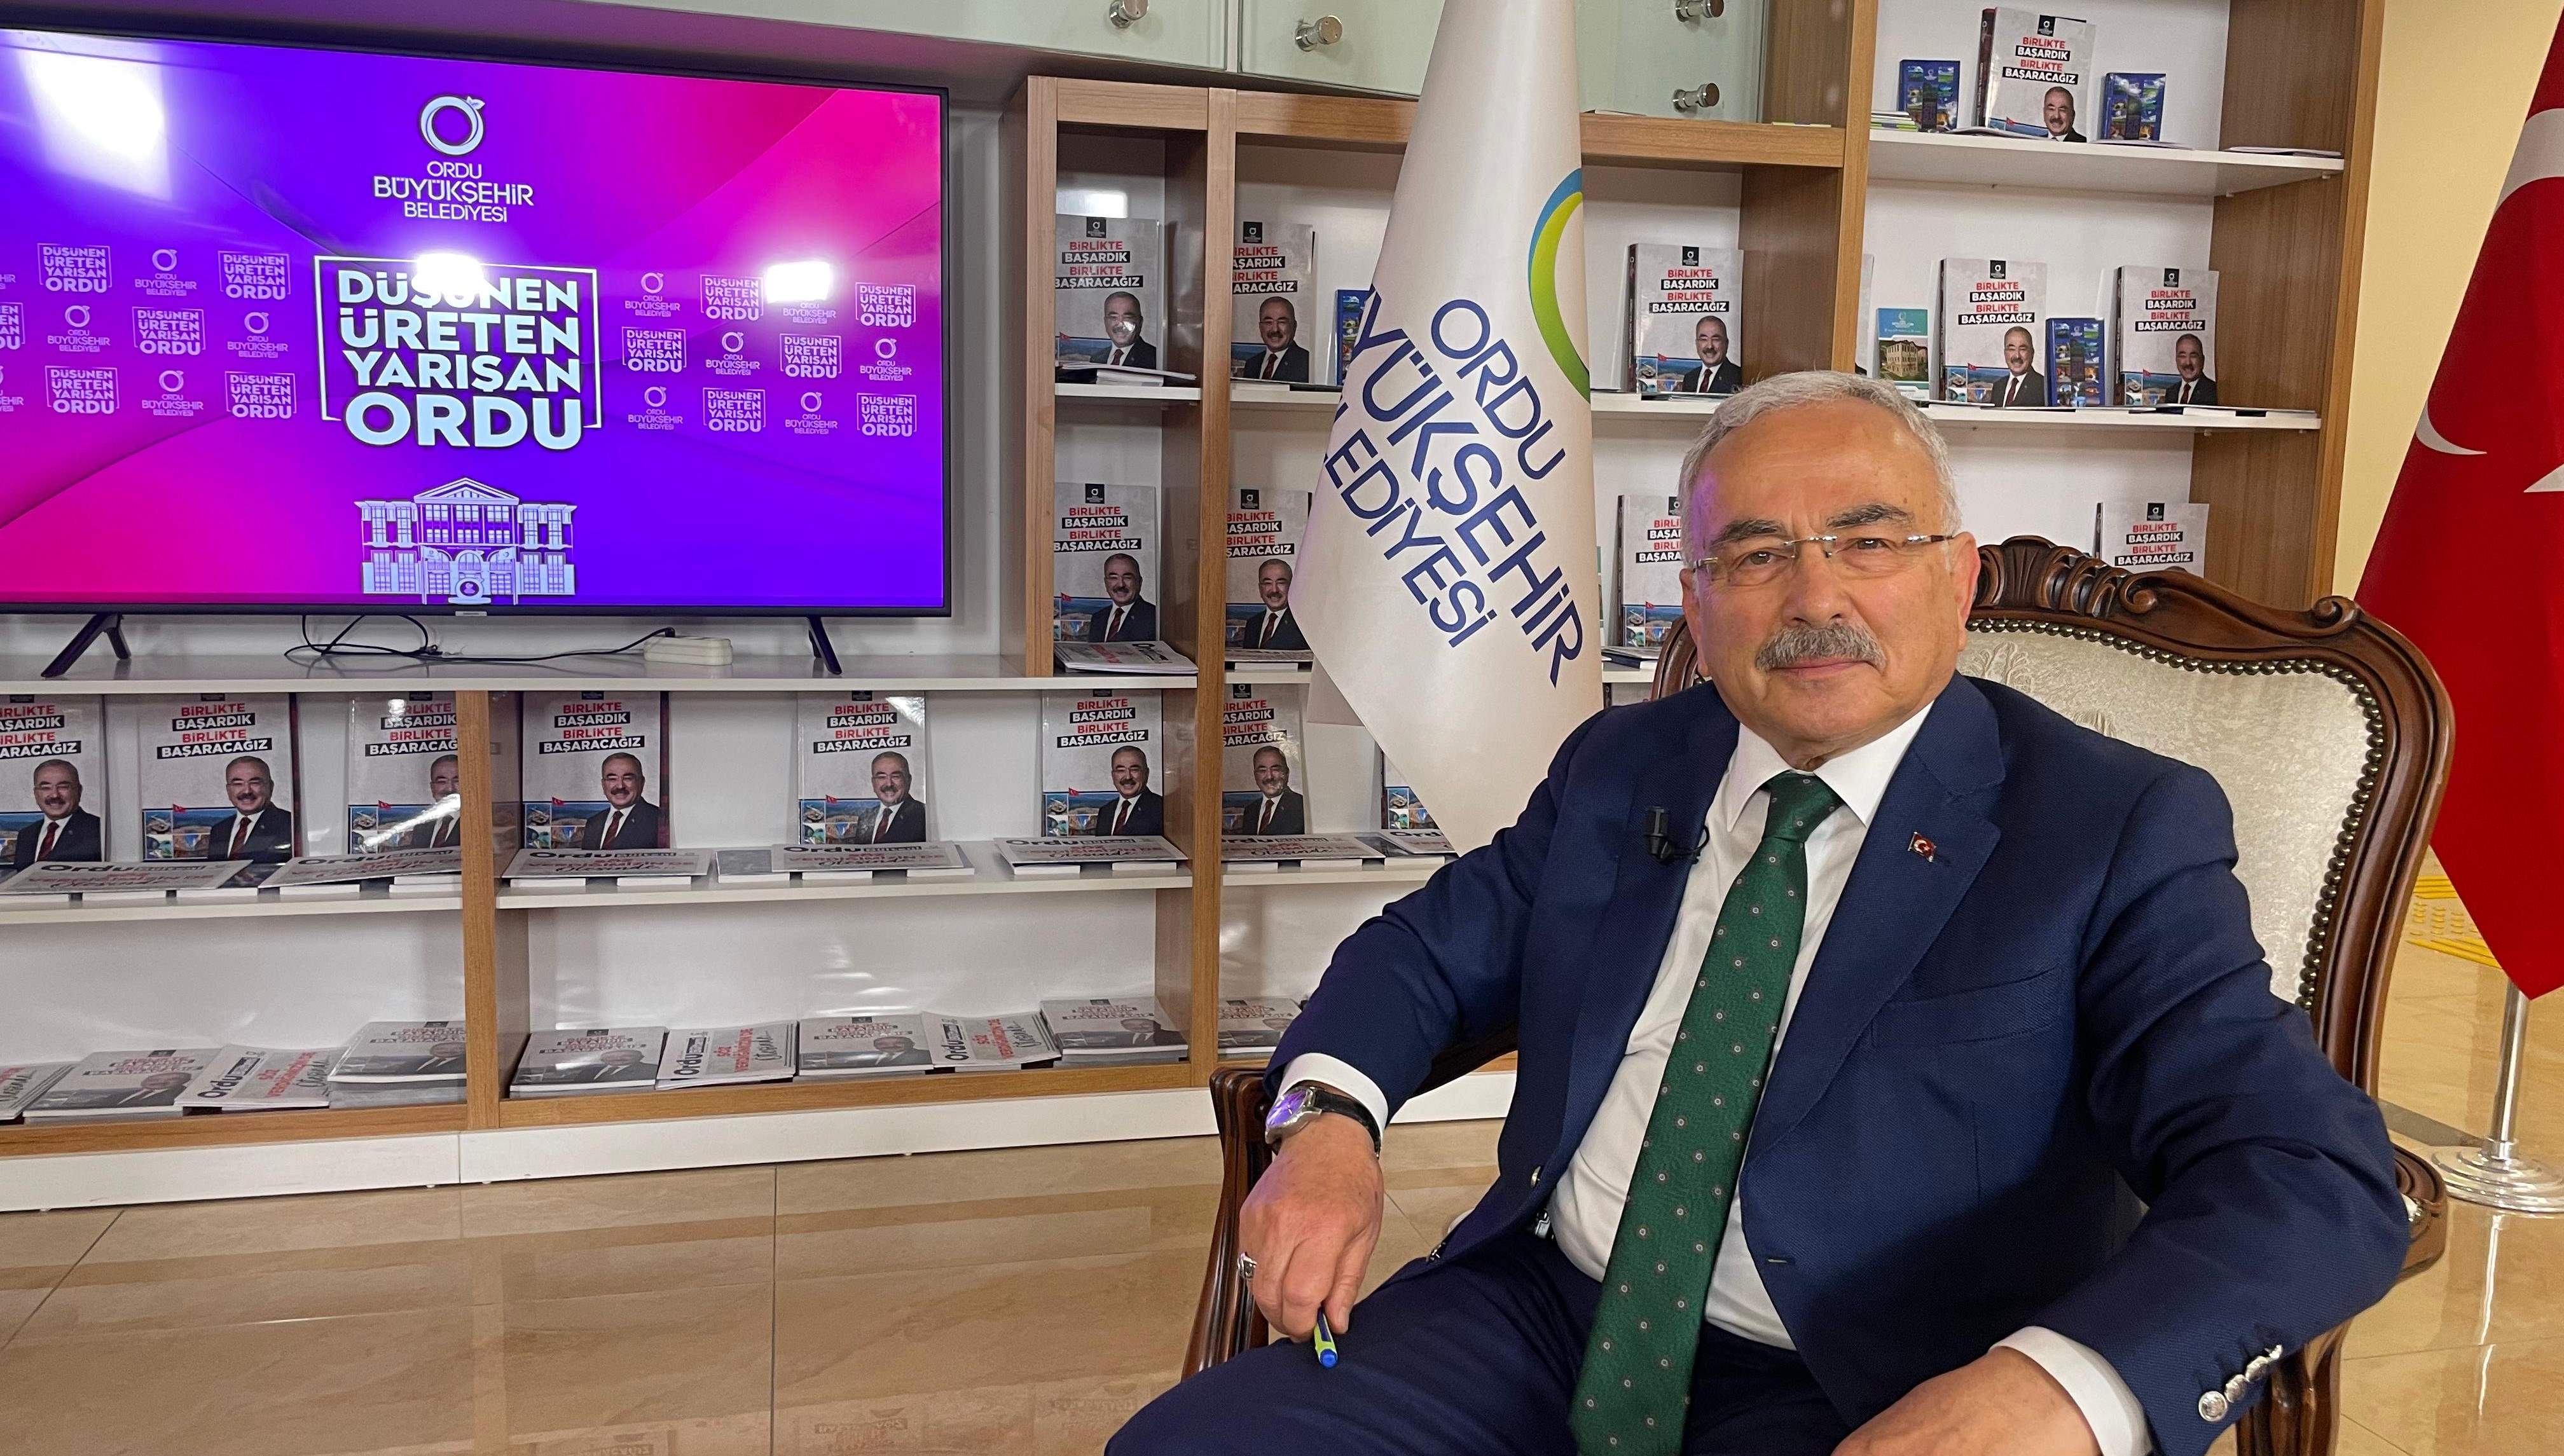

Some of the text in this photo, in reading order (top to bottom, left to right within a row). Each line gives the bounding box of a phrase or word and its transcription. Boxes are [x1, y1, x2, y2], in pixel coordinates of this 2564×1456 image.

[2023, 37, 2065, 49] BİRLİKTE
[2017, 47, 2069, 61] BAŞARDIK
[2020, 59, 2063, 72] BİRLİKTE
[2006, 68, 2076, 84] BAŞARACAĞIZ
[427, 161, 481, 179] ORDU
[374, 175, 534, 206] BÜYÜKŞEHİR
[404, 203, 507, 222] BELEDİYESİ
[1070, 241, 1123, 251] BİRLİKTE
[1234, 247, 1278, 256] İRLİKTE
[44, 257, 106, 268] ÜRETEN
[1065, 252, 1127, 264] BAŞARDIK
[1233, 258, 1282, 268] AŞARDIK
[224, 264, 285, 275] ÜRETEN
[1070, 266, 1123, 275] BİRLİKTE
[1233, 271, 1278, 280] İRLİKTE
[1668, 269, 1712, 277] BİRLİKTE
[45, 277, 107, 293] ORDU
[1056, 276, 1140, 288] BAŞARACAĞIZ
[1234, 282, 1294, 293] ARACAĞIZ
[1664, 280, 1716, 290] BAŞARDIK
[1976, 282, 2019, 291] BİRLİKTE
[226, 285, 286, 300] ORDU
[705, 287, 759, 298] ÜRETEN
[1667, 292, 1712, 301] BİRLİKTE
[1971, 292, 2023, 302] BAŞARDIK
[2151, 290, 2191, 299] BİRLİKTE
[860, 294, 911, 305] ÜRETEN
[2147, 299, 2194, 310] BAŞARDIK
[706, 306, 759, 320] ORDU
[1652, 301, 1726, 313] BAŞARACAĞIZ
[1976, 303, 2019, 313] BİRLİKTE
[860, 313, 912, 327] ORDU
[1961, 312, 2032, 324] BAŞARACAĞIZ
[2151, 312, 2189, 320] BİRLİKTE
[139, 320, 199, 331] ÜRETEN
[2138, 320, 2203, 332] BAŞARACAĞIZ
[340, 308, 579, 356] ÜRETEN
[139, 340, 200, 355] ORDU
[627, 339, 682, 350] ÜRETEN
[784, 346, 837, 357] ÜRETEN
[342, 350, 581, 393] YARIŞAN
[628, 358, 682, 373] ORDU
[785, 364, 837, 378] ORDU
[51, 379, 113, 390] ÜRETEN
[231, 385, 291, 395] ÜRETEN
[1431, 299, 1566, 480] ORDU
[53, 399, 114, 414] ORDU
[708, 400, 761, 410] ÜRETEN
[862, 405, 912, 416] ÜRETEN
[231, 404, 292, 419] ORDU
[345, 392, 581, 450] ORDU
[708, 418, 761, 432] ORDU
[862, 423, 913, 437] ORDU
[1351, 284, 1583, 689] YÜKŞEHİR
[1070, 507, 1120, 516] BİRLİKTE
[1065, 517, 1125, 528] BAŞARDIK
[1227, 522, 1279, 533] AŞARDIK
[2133, 523, 2177, 532] BİRLİKTE
[1070, 530, 1121, 539] BİRLİKTE
[1325, 429, 1497, 647] EDİYESİ
[1650, 530, 1681, 539] BAŞA
[2128, 533, 2181, 544] BAŞARDIK
[1054, 540, 1138, 552] BAŞARACAĞIZ
[1227, 545, 1291, 558] ŞARACAĞIZ
[1654, 542, 1680, 551] BİRLİ
[2132, 544, 2176, 554] BİRLİKTE
[1639, 552, 1681, 563] BAŞARA
[2118, 553, 2190, 565] BAŞARACAĞIZ
[0, 704, 55, 717] İRLİKTE
[181, 703, 245, 716] BİRLİKTE
[406, 703, 451, 714] RLİKTE
[563, 702, 622, 713] BİRLİKTE
[835, 703, 890, 714] BİRLİKTE
[1077, 699, 1128, 710] BİRLİKTE
[558, 713, 627, 727] BAŞARDIK
[830, 713, 894, 727] BAŞARDIK
[1073, 708, 1133, 722] BAŞARDIK
[1223, 710, 1272, 724] AŞARDIK
[0, 717, 62, 732] AŞARDIK
[176, 714, 252, 730] BAŞARDIK
[1078, 722, 1128, 733] BİRLİKTE
[0, 732, 55, 744] İRLİKTE
[182, 729, 246, 743] BİRLİKTE
[390, 729, 451, 741] BİRLİKTE
[563, 727, 622, 739] BİRLİKTE
[835, 727, 890, 739] BİRLİKTE
[1061, 729, 1145, 747] BAŞARACAĞIZ
[1223, 731, 1284, 746] ŞARACAĞIZ
[1, 740, 77, 758] ARACAĞIZ
[162, 739, 268, 758] BAŞARACAĞIZ
[369, 738, 458, 757] BAŞARACAĞ
[544, 735, 641, 753] BAŞARACAĞIZ
[817, 734, 907, 752] BAŞARACAĞIZ
